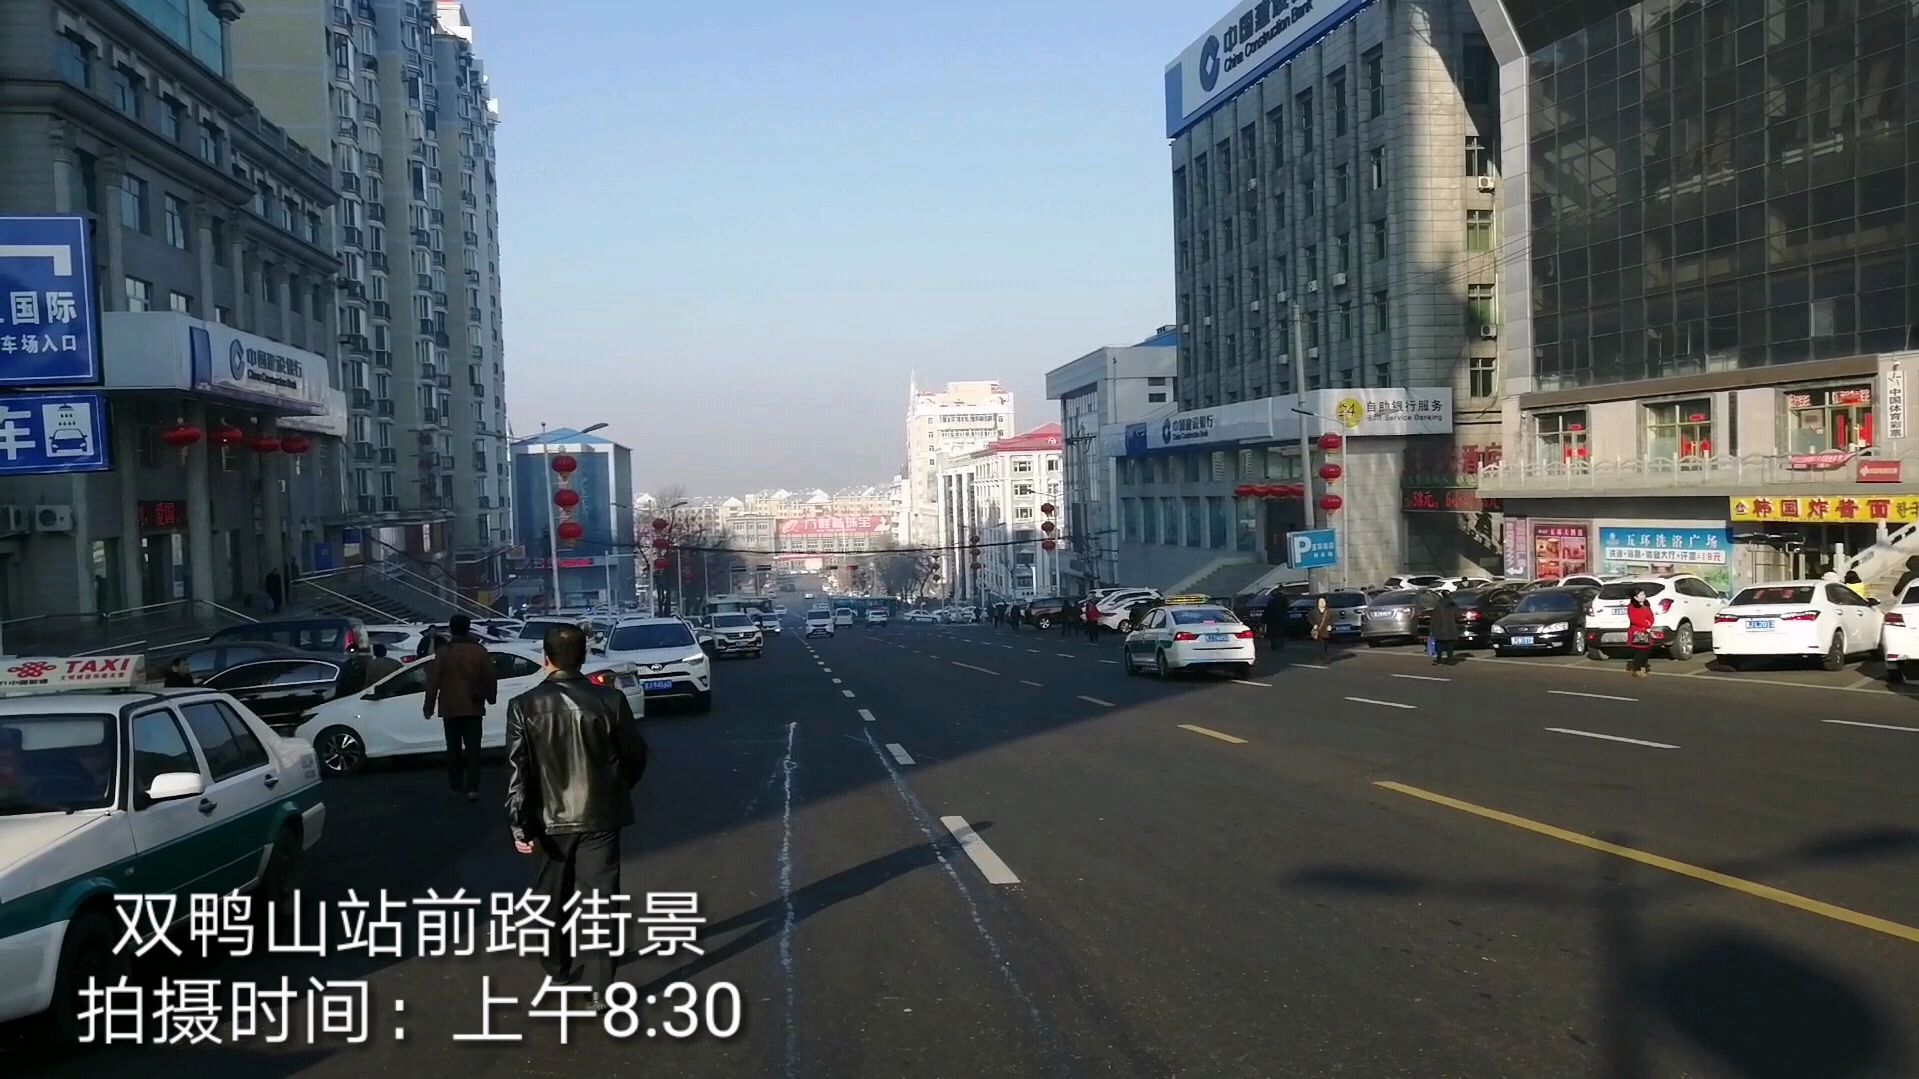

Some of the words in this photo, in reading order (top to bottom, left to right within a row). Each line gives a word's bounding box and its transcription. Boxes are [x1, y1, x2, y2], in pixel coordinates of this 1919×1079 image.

[1224, 51, 1244, 72] China
[1245, 16, 1291, 57] Construction
[0, 291, 77, 325] 国际
[0, 334, 77, 354] 车场入口
[1367, 399, 1443, 413] 自助银行服务
[1889, 388, 1902, 438] 中国体育彩票
[1414, 414, 1443, 422] Banking
[1753, 498, 1891, 518] 韩国炸酱面
[1294, 536, 1312, 563] P
[1626, 532, 1718, 549] 五环洗浴广场
[65, 658, 130, 674] TAXI
